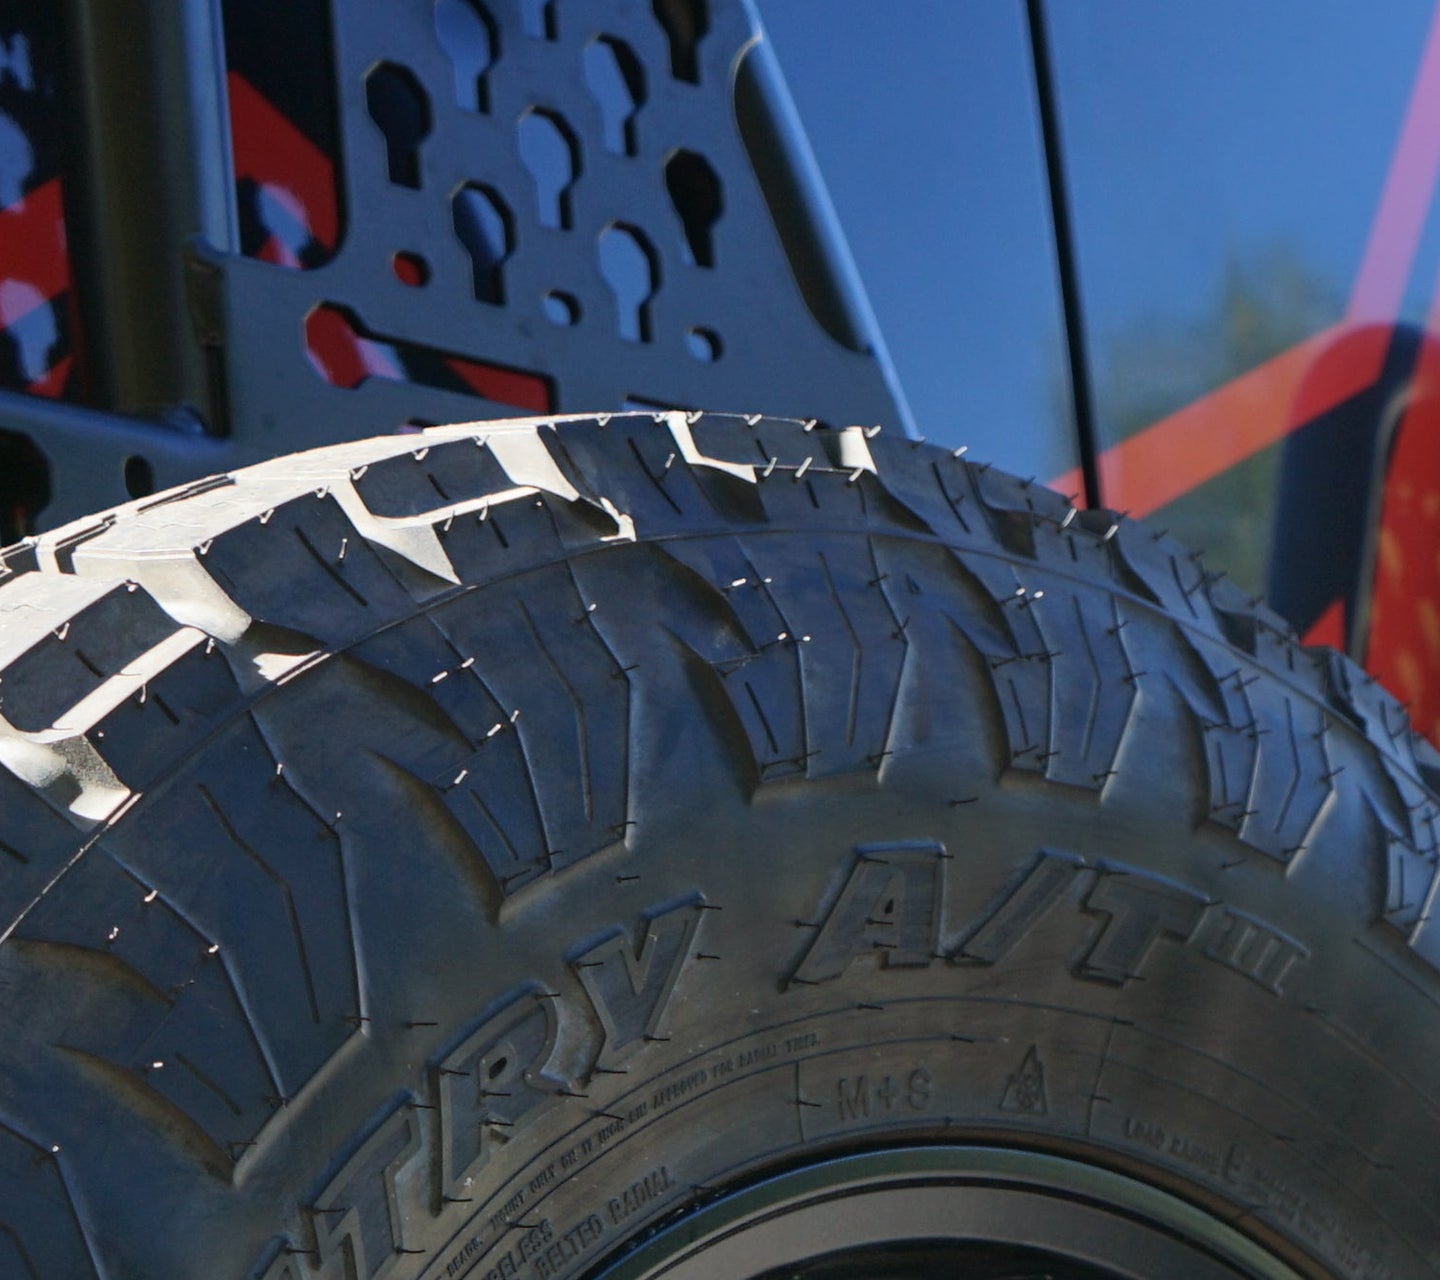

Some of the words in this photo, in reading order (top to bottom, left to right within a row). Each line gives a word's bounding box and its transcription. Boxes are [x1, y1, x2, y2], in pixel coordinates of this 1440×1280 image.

[776, 838, 1212, 990] A/T
[1200, 906, 1312, 998] III
[829, 1064, 933, 1125] M+S
[601, 1162, 678, 1227] RADIAL
